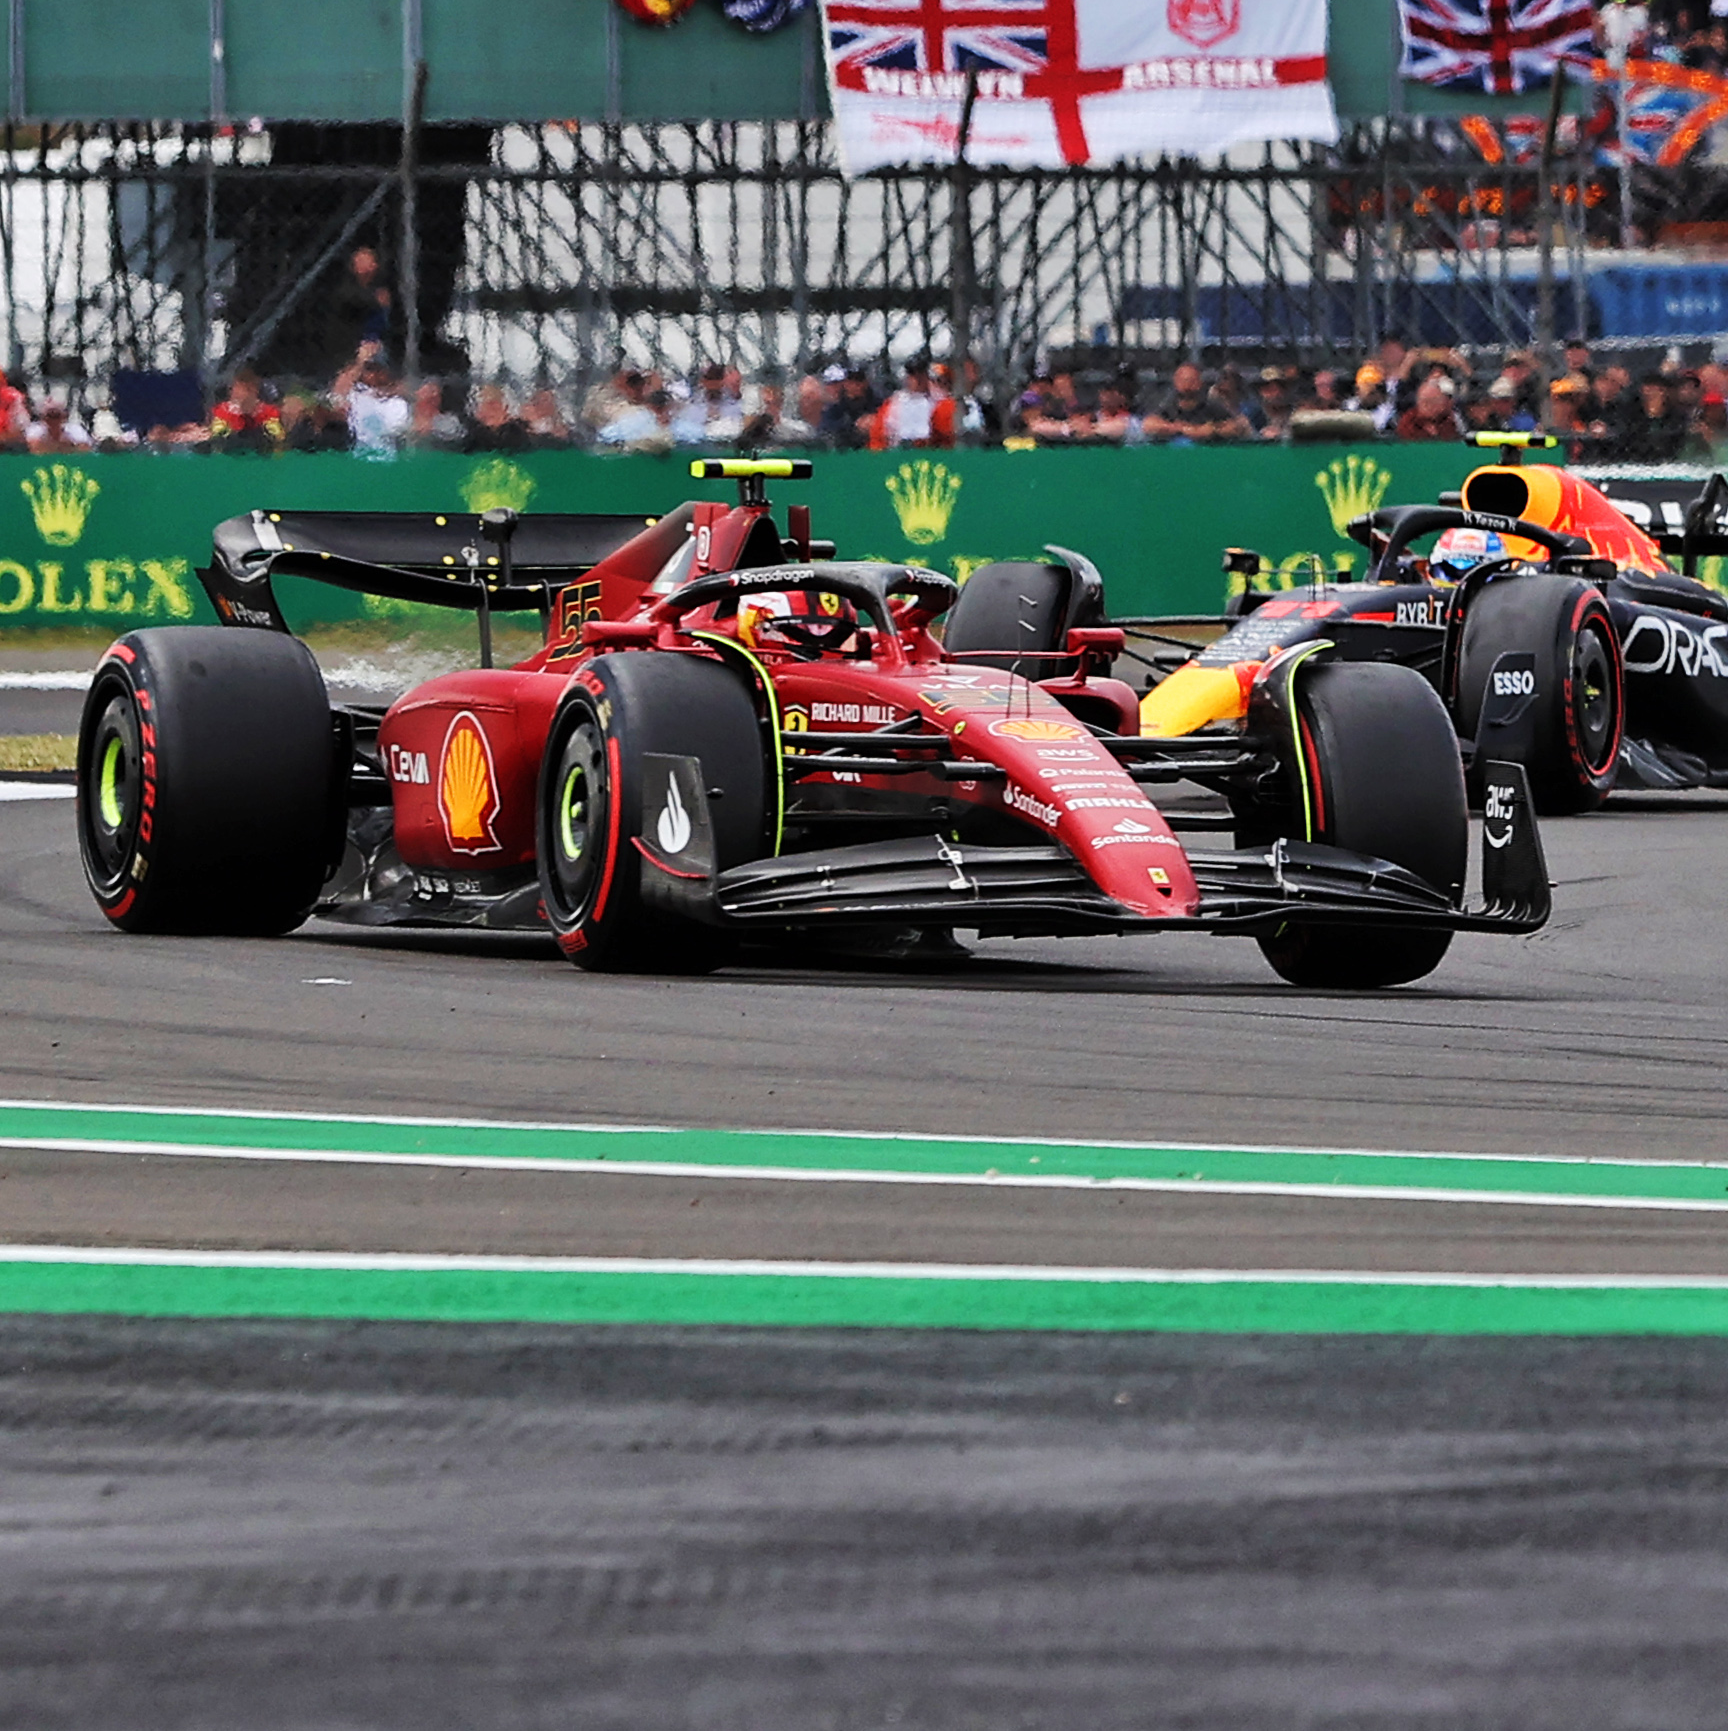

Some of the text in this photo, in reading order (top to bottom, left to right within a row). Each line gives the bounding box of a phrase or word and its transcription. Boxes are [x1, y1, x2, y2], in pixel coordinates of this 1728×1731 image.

[1122, 58, 1276, 88] ARSENAL
[0, 557, 194, 617] OLEX
[741, 569, 815, 586] Snapdragon
[1493, 670, 1535, 696] ESSO
[811, 702, 897, 725] RICHARD MILLE
[1012, 785, 1062, 828] Santander
